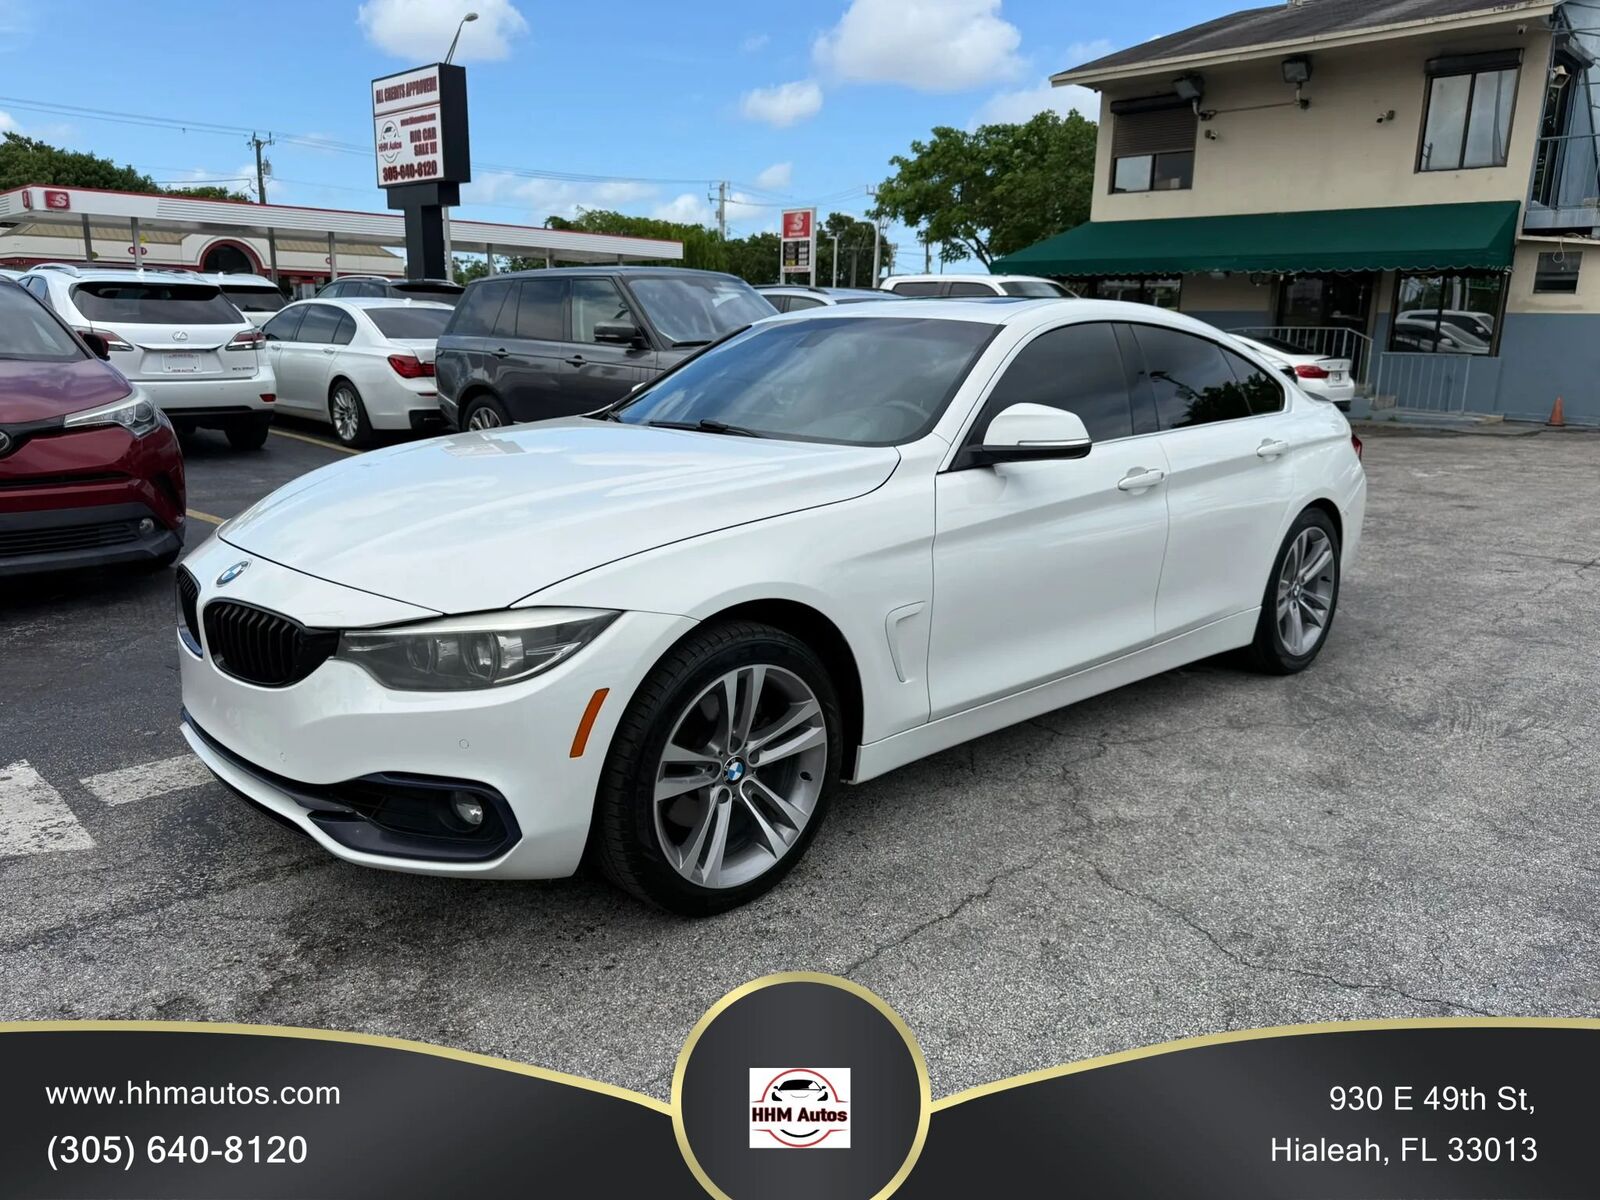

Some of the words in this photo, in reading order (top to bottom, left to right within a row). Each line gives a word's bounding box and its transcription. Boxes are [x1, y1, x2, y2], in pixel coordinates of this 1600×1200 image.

[410, 129, 421, 143] BIG
[423, 127, 437, 141] CAR
[414, 142, 429, 157] SALE
[383, 160, 437, 181] 305-640-8120
